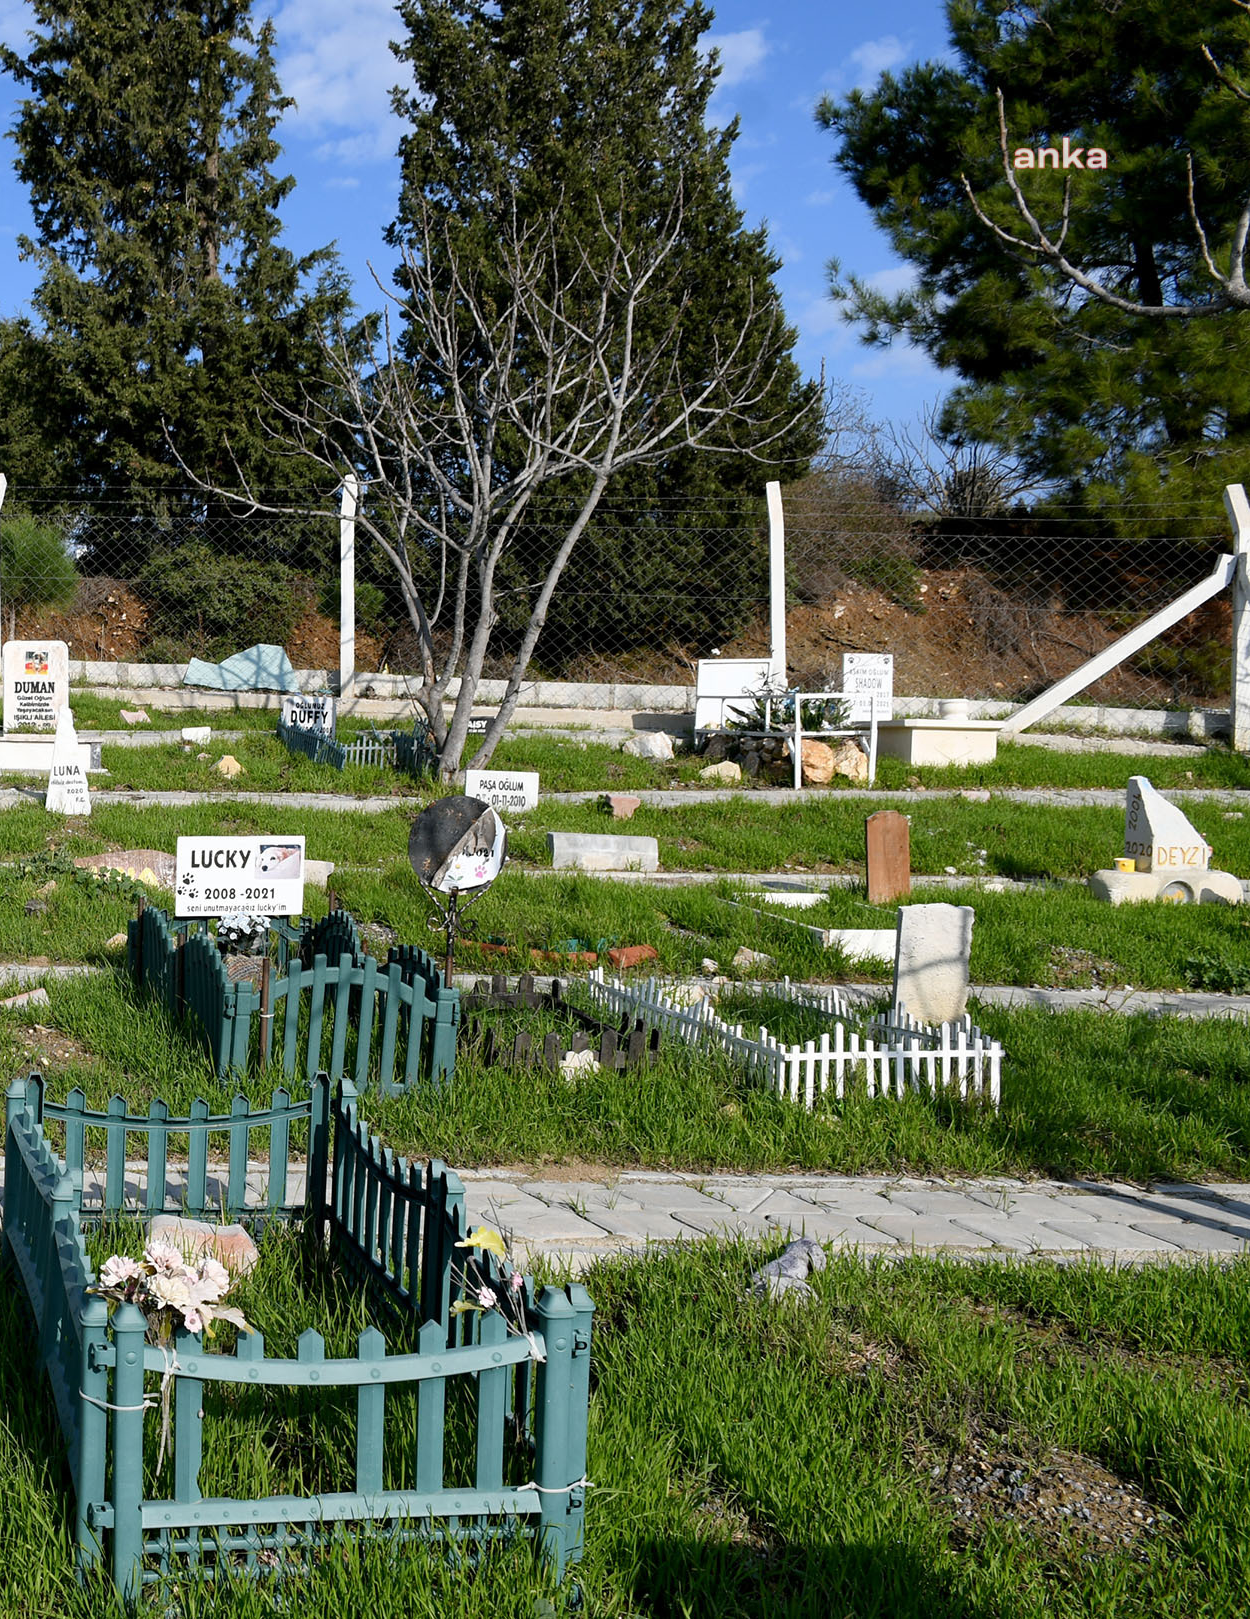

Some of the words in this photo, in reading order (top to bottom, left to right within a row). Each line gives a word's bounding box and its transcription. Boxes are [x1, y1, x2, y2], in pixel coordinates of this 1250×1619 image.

[14, 681, 55, 693] DUMAN
[855, 677, 882, 689] SHADOW
[290, 710, 328, 724] DUFFY
[467, 720, 487, 729] AISY
[53, 765, 80, 776] LUNA
[479, 779, 497, 792] PAŞA
[498, 778, 524, 791] OĞLUM
[491, 794, 526, 807] 01-11-2010
[1125, 840, 1153, 857] 2020
[191, 849, 251, 869] LUCKY
[204, 887, 236, 900] 2008
[187, 903, 202, 912] seni
[257, 903, 287, 912] lucky'im
